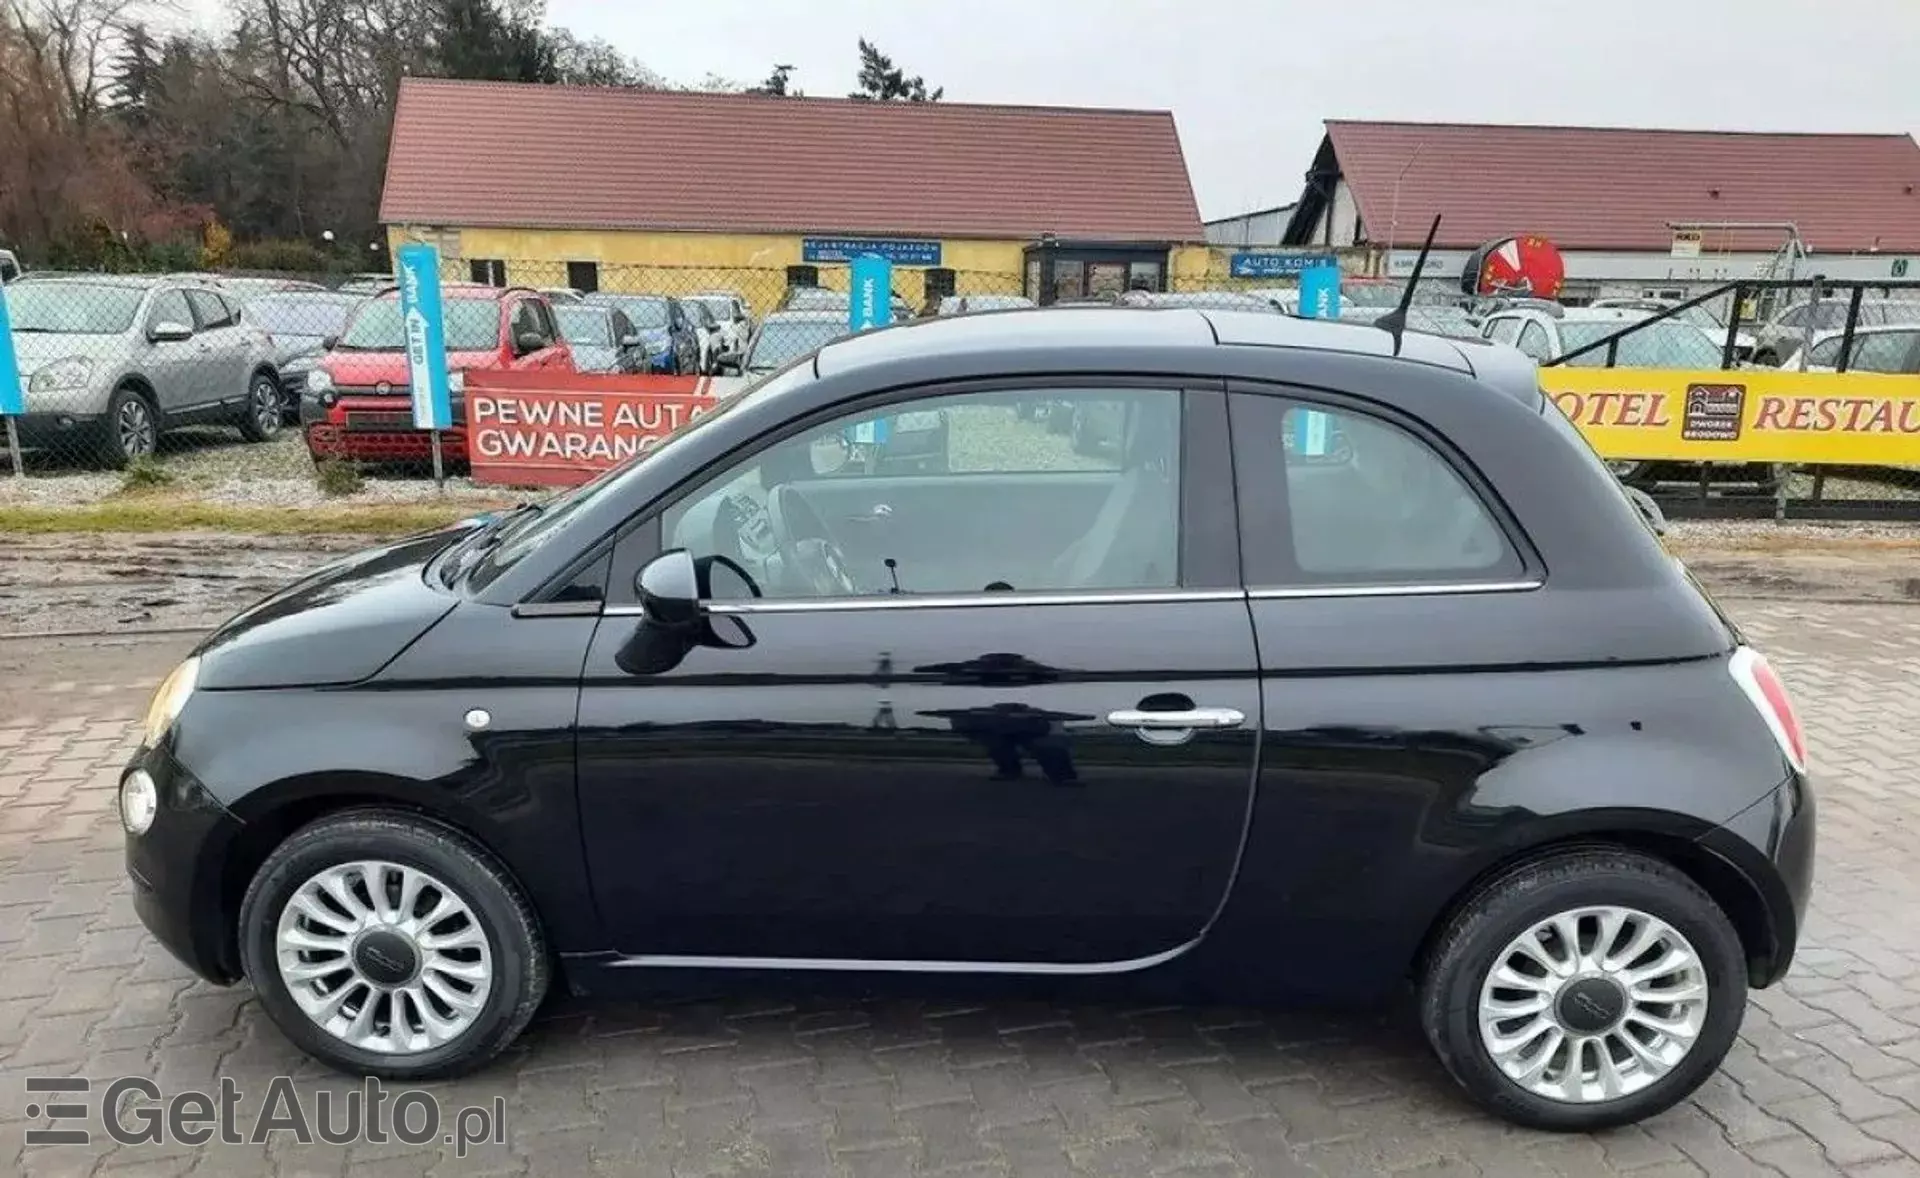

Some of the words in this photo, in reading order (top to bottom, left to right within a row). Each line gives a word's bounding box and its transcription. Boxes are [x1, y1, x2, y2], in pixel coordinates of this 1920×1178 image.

[1243, 257, 1278, 268] AUTO
[863, 278, 874, 317] BANK
[409, 317, 421, 334] IN
[411, 337, 424, 366] GET
[474, 396, 604, 428] PEWNE
[1753, 396, 1920, 433] RESTAU
